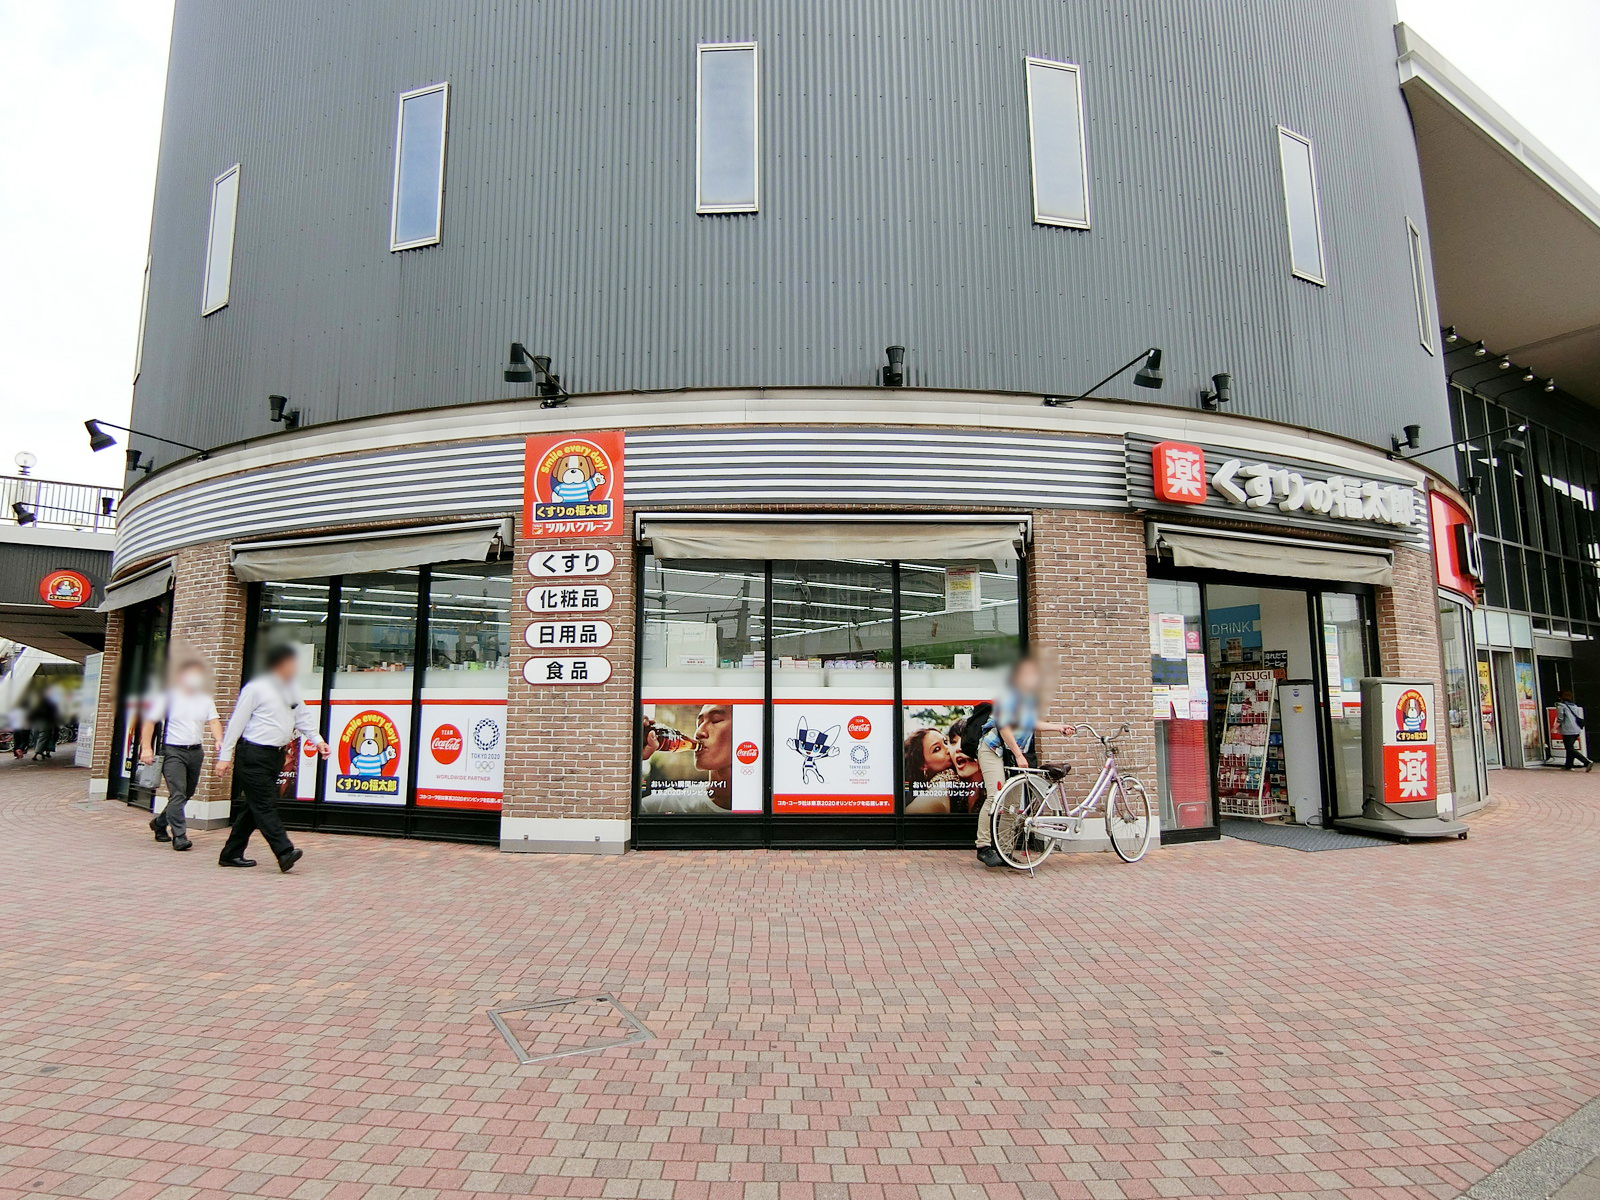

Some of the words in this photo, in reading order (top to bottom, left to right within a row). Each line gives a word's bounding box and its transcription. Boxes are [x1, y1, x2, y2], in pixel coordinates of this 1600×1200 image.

[541, 450, 563, 474] Smile
[564, 445, 591, 456] every
[590, 451, 608, 471] day!
[1166, 448, 1201, 497] 薬
[1212, 458, 1416, 527] くすりの福太郎
[537, 504, 608, 517] くすりの福太郎
[545, 522, 613, 533] ツルハグループ
[542, 553, 600, 573] くすり
[540, 589, 599, 608] 化粧品
[540, 625, 597, 644] 日用品
[1211, 621, 1251, 635] DRINK
[546, 661, 588, 680] 食品
[1234, 671, 1271, 681] ATSUGI
[342, 718, 362, 743] Smile
[362, 714, 386, 727] every
[384, 721, 399, 744] day!
[1398, 750, 1427, 797] 薬
[337, 778, 397, 792] くすりの福太郎
